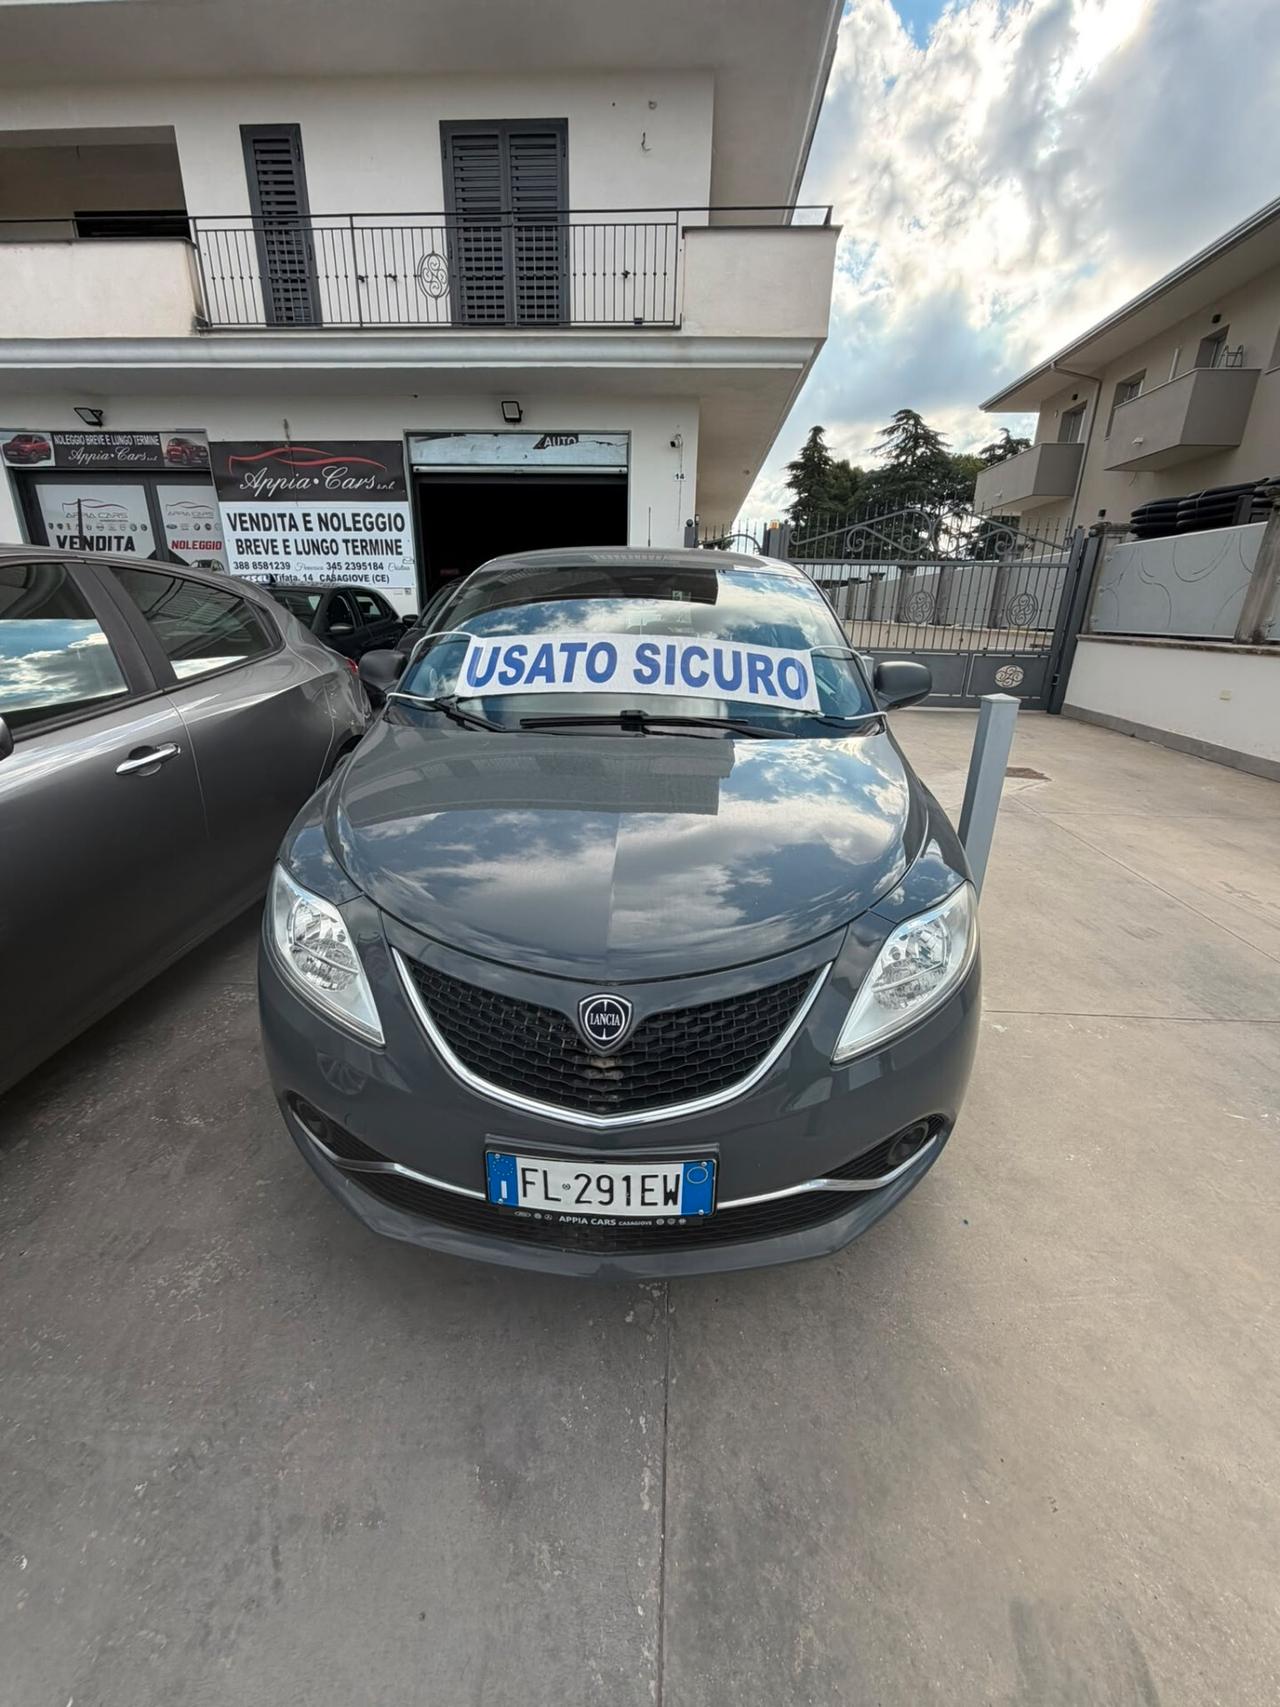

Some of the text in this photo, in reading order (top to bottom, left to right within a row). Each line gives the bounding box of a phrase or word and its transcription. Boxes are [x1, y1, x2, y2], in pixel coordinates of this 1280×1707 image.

[53, 434, 160, 445] NOLEGGIO BREVE E LUNGO TERMINE
[544, 436, 576, 447] AUTO
[226, 512, 406, 532] VENDITA E NOLEGGIO
[56, 535, 136, 552] VENDITA
[171, 540, 222, 550] NOLEGGIO
[236, 538, 403, 556] BREVE E LUNGO TERMINE
[233, 562, 250, 570] 388
[252, 562, 290, 570] 8581239
[326, 562, 342, 570] 345
[344, 562, 384, 570] 2395184
[302, 574, 314, 582] 14
[319, 574, 370, 582] CASAGIOVE
[372, 574, 390, 584] (CE)
[466, 641, 809, 701] USATO SICURO
[590, 1012, 620, 1026] LANCIA
[558, 1216, 588, 1225] APPIA
[590, 1218, 616, 1226] CARS
